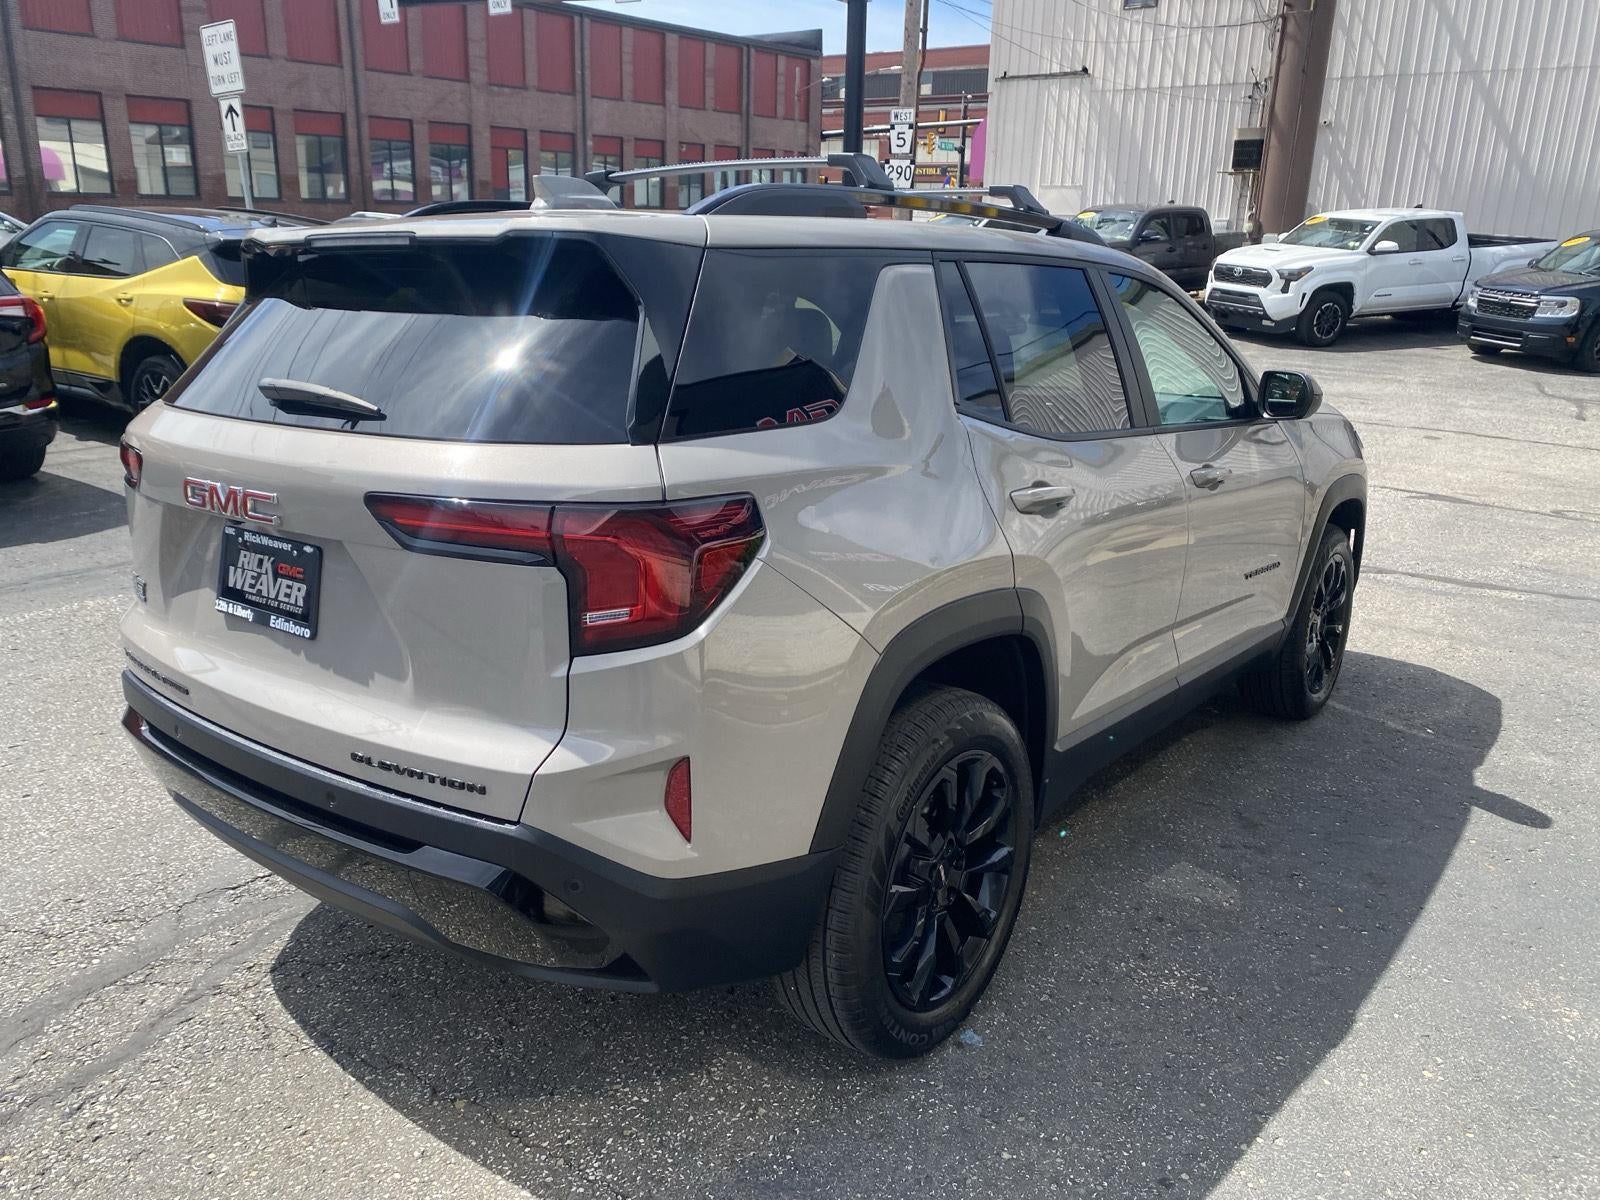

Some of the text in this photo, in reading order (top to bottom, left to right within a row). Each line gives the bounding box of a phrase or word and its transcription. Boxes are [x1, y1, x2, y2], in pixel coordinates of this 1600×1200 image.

[205, 30, 234, 46] LEFT LANE
[213, 51, 232, 66] MUST
[211, 71, 241, 87] TURN LEFT
[893, 111, 912, 121] WEST
[226, 133, 245, 143] BLACK
[896, 131, 906, 148] 5
[887, 165, 912, 181] 290
[183, 477, 281, 525] GMC
[243, 531, 293, 552] RickWeaver
[237, 550, 305, 579] RICK GMC
[227, 565, 307, 607] WEAVER
[233, 603, 254, 622] Liberty
[245, 593, 303, 614] FAMOUS FOR SERVICE
[269, 615, 311, 639] Edinboro
[350, 751, 487, 796] ELEVATION
